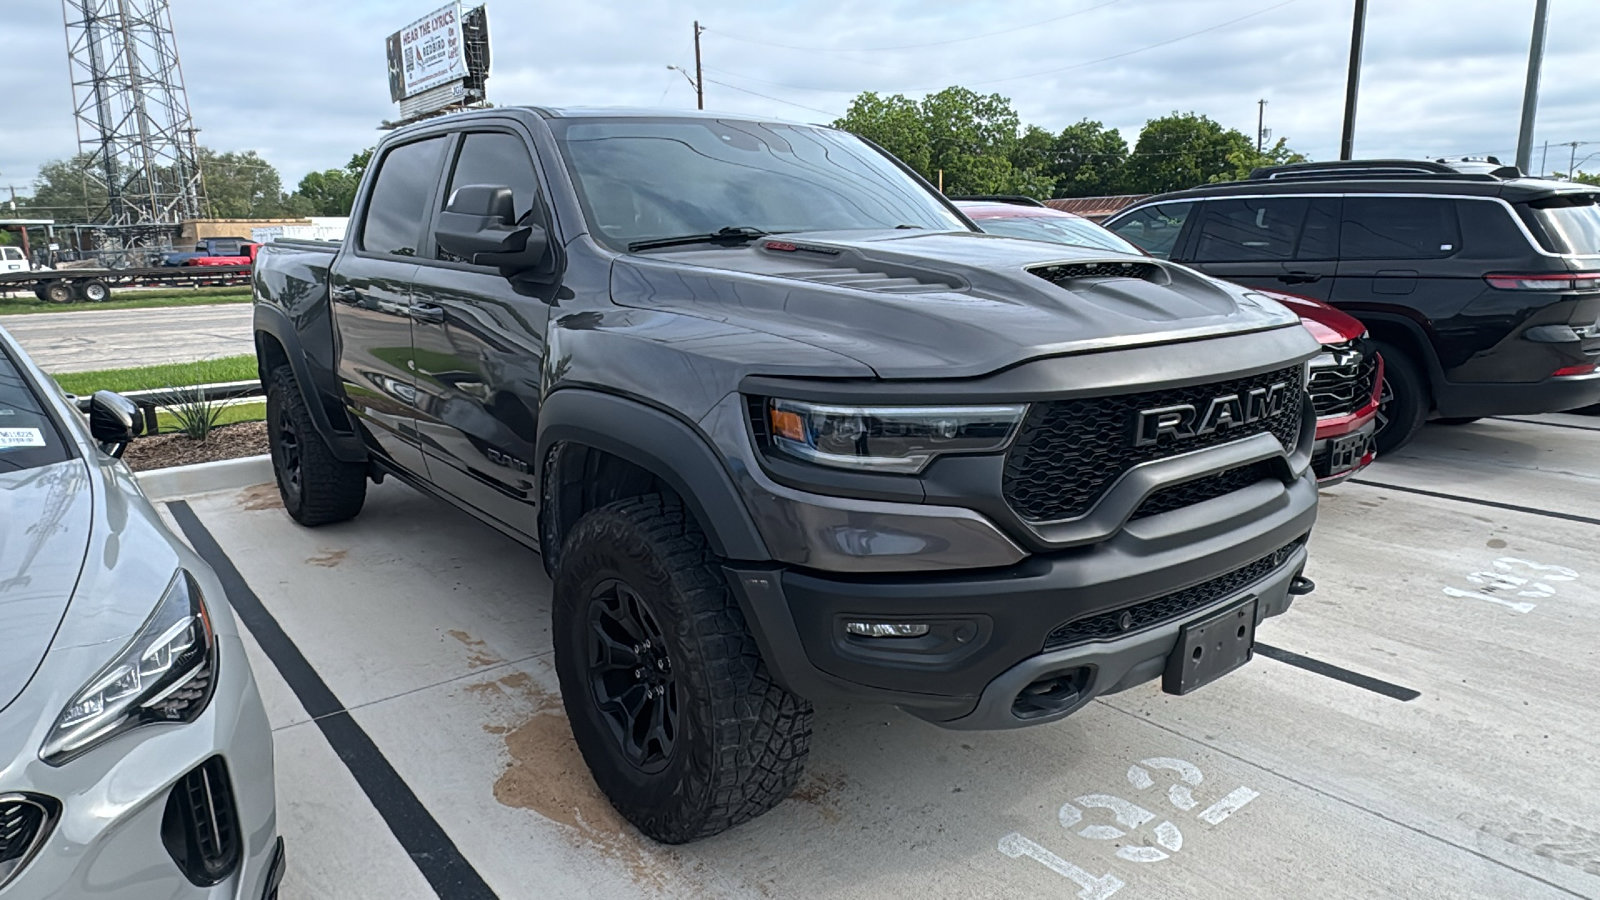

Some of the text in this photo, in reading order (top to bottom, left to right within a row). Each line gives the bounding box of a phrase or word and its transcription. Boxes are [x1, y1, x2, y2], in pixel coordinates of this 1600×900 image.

[403, 28, 418, 46] HEAR
[419, 21, 430, 37] THE
[423, 39, 445, 55] REDBIRD
[1136, 382, 1286, 447] RAM
[1442, 556, 1580, 614] 193
[998, 756, 1260, 900] 192
